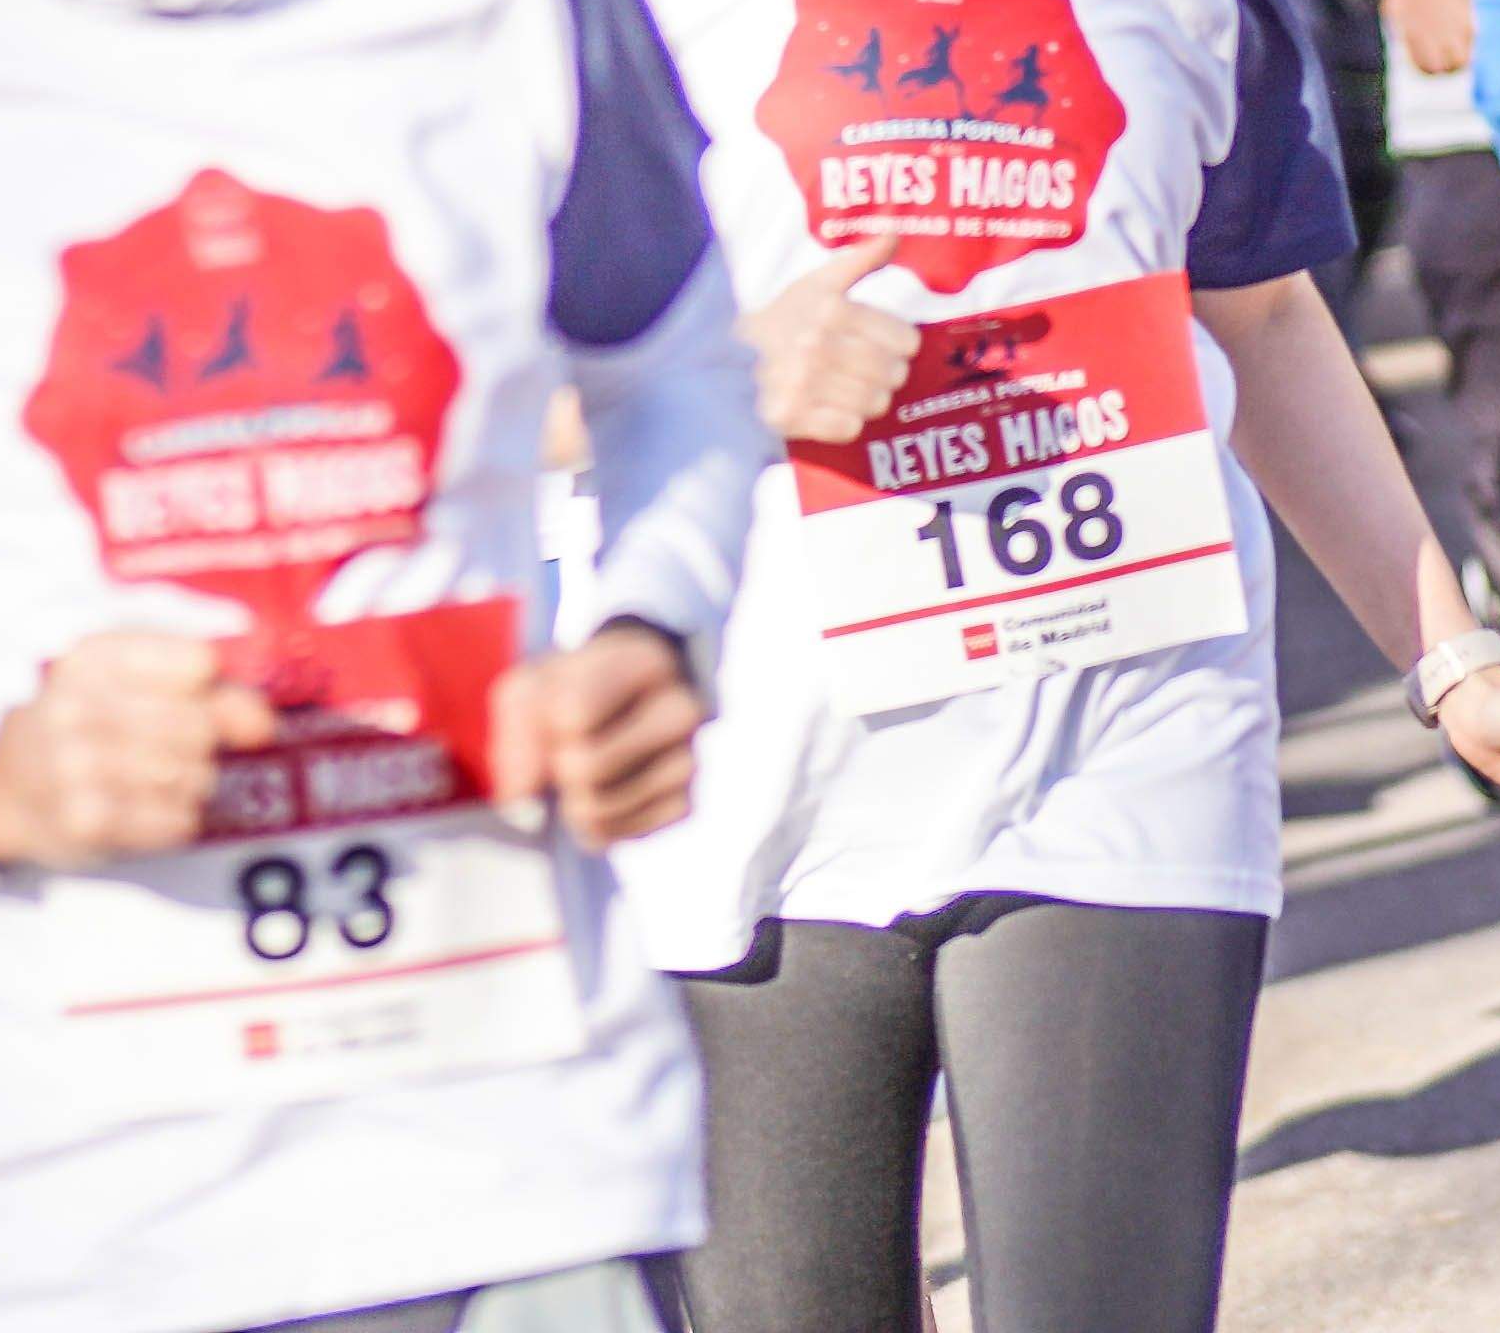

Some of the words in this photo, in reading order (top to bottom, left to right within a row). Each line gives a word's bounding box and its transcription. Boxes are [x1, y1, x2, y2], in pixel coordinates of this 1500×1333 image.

[820, 153, 937, 209] REYES
[951, 157, 1077, 209] MAGOS
[866, 421, 990, 491] REYES
[1000, 388, 1130, 468] MAGOS
[897, 386, 991, 424] CARRERA
[994, 369, 1088, 398] POPULAR
[916, 471, 1124, 591] 168
[237, 843, 393, 960] 83
